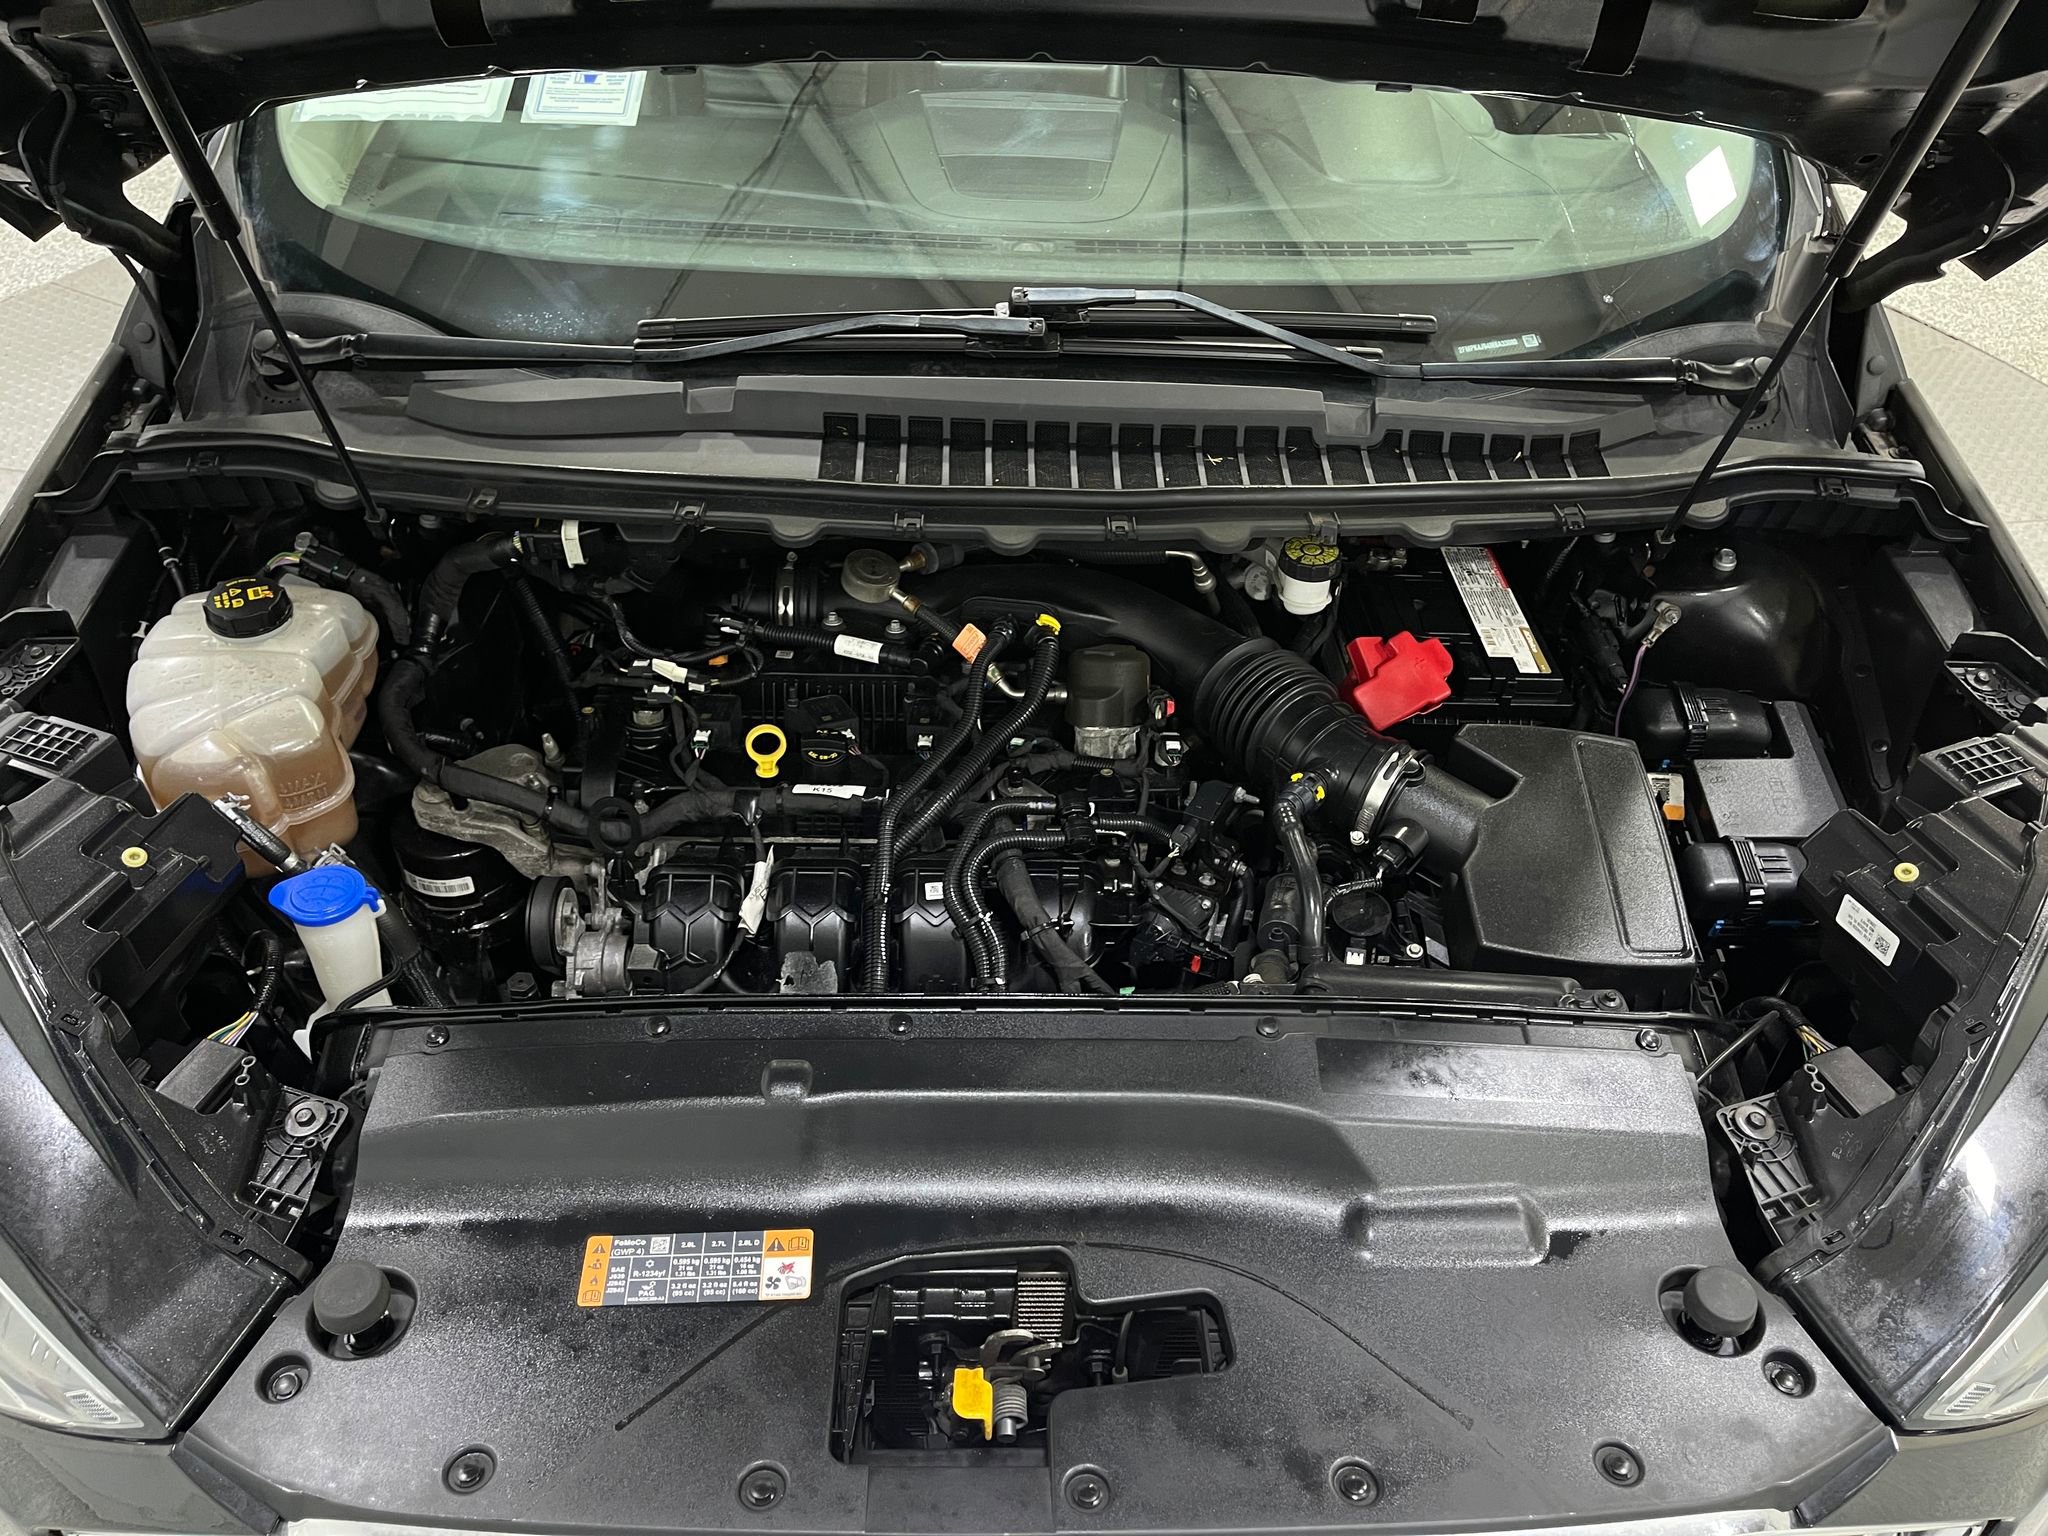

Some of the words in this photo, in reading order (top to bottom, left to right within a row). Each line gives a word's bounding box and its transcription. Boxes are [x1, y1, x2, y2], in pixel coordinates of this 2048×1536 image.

[812, 786, 833, 794] K15
[614, 1238, 647, 1247] FoMoCo
[711, 1240, 727, 1248] 2.7L
[610, 1247, 635, 1257] (GWP
[635, 1247, 645, 1257] 4)
[632, 1269, 667, 1278] R-1234yf
